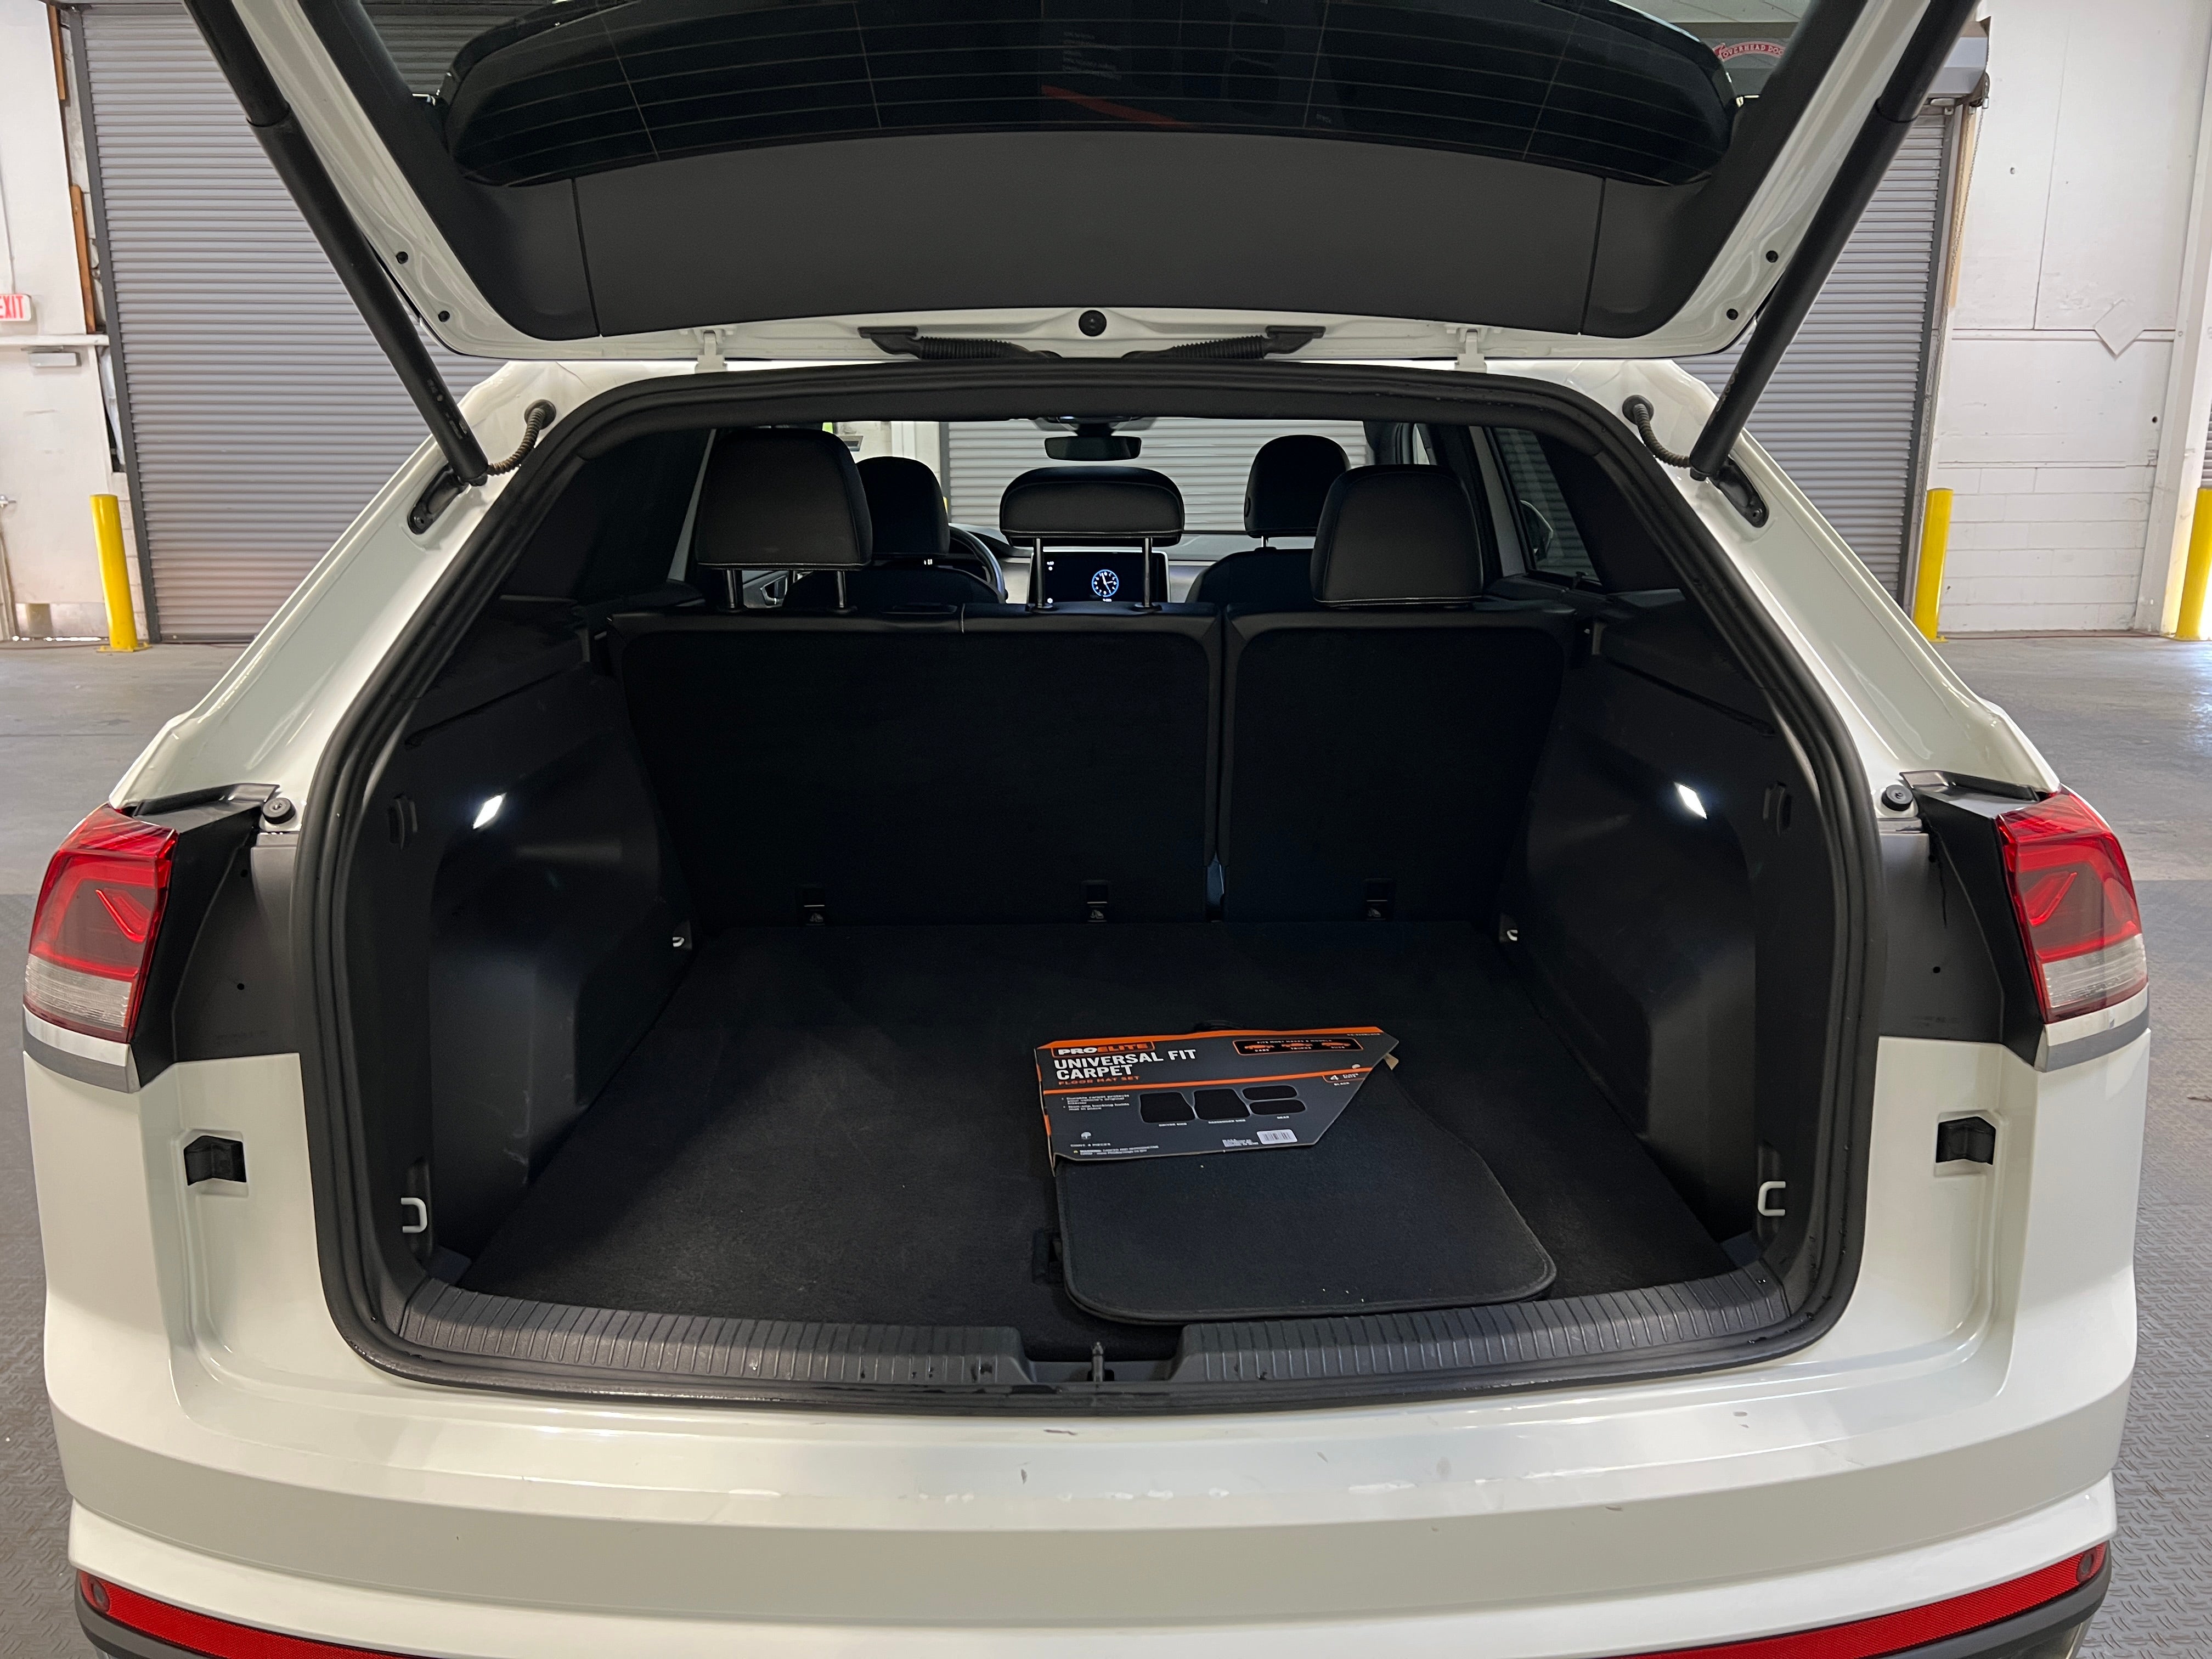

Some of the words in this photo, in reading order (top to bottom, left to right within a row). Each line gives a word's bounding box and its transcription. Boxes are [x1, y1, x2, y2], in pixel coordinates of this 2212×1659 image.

[1723, 44, 1765, 58] OVERHEAD
[1768, 47, 1784, 55] DOO
[1058, 1043, 1148, 1056] PROELITE
[1054, 1052, 1164, 1069] UNIVERSAL
[1167, 1049, 1197, 1060] FIT
[1056, 1064, 1133, 1080] CARPET
